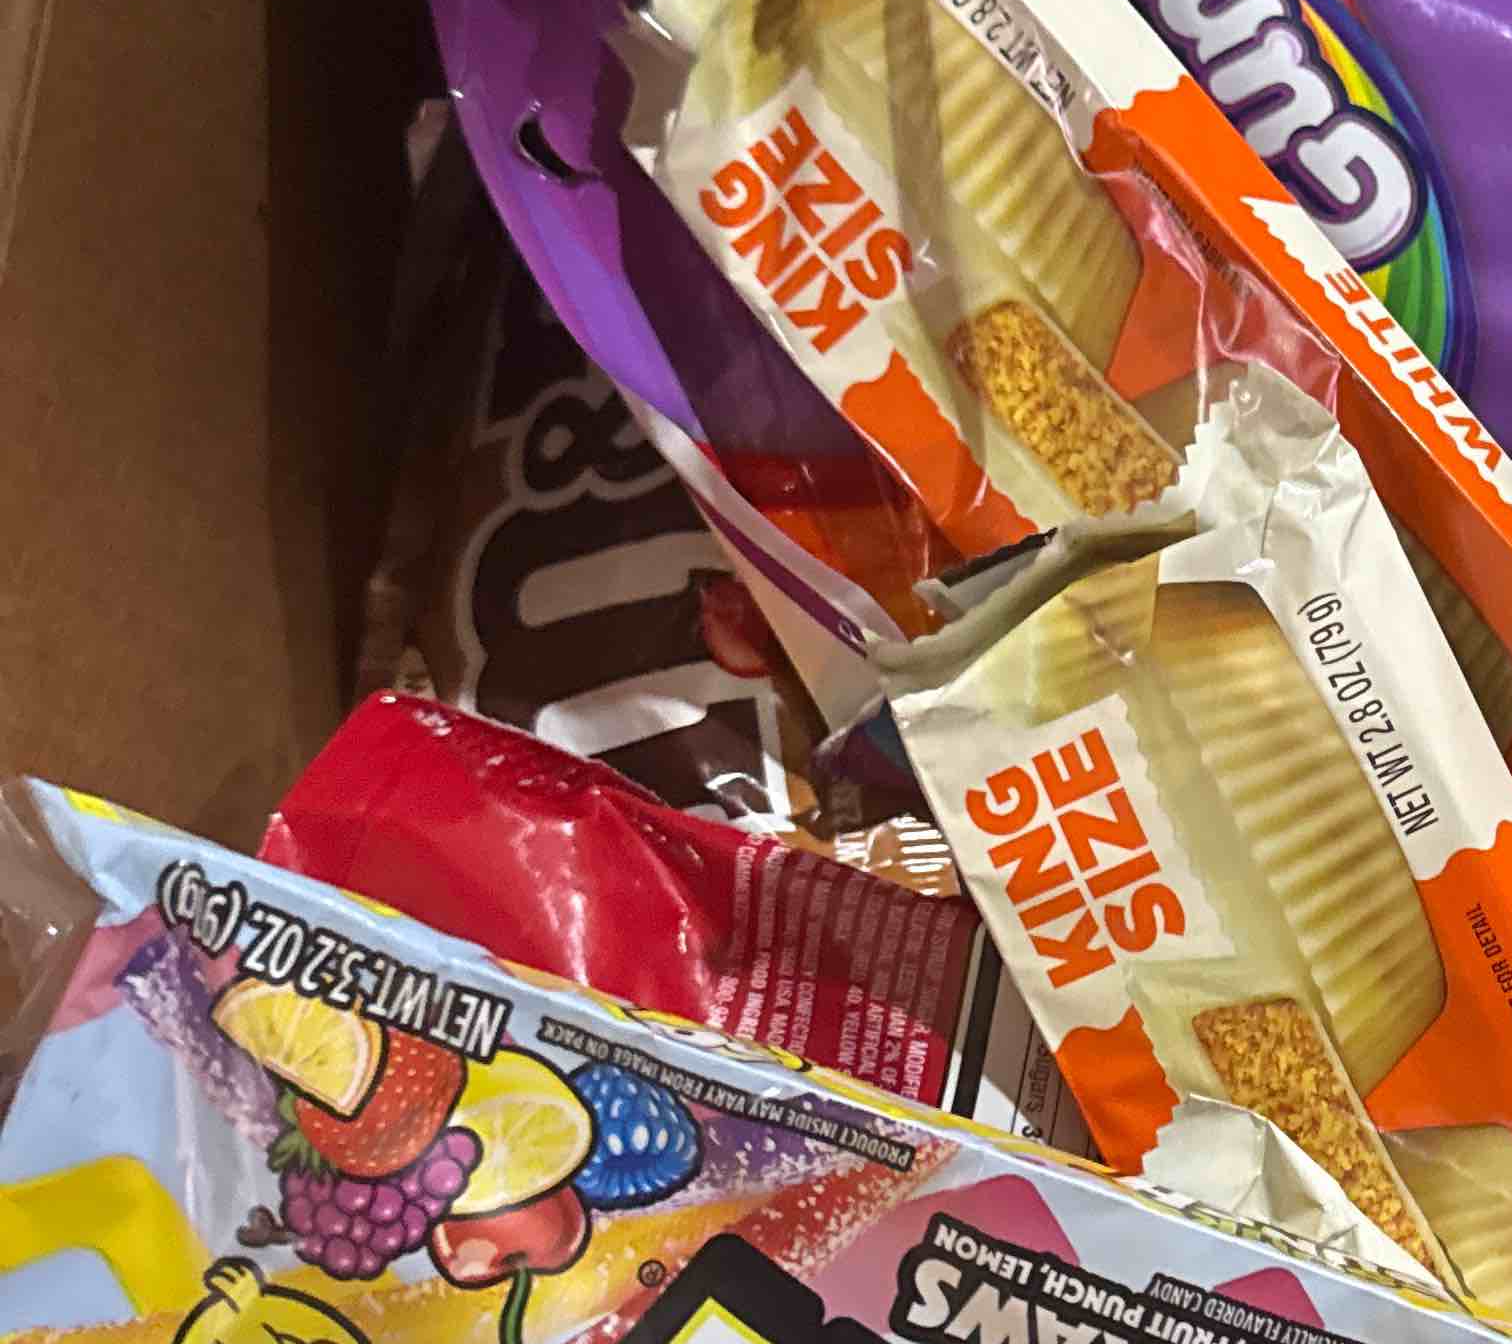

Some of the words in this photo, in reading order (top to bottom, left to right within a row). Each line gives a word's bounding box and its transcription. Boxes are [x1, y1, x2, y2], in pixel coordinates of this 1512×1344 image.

[1028, 62, 1078, 115] NET
[750, 104, 915, 301] SIZE
[701, 160, 868, 354] KING
[1321, 258, 1509, 475] WHITE
[1327, 659, 1375, 705] OZ
[1345, 695, 1397, 747] 2.8
[1365, 735, 1416, 787] WT
[1384, 776, 1441, 837] NET
[1031, 726, 1186, 957] SIZE
[965, 767, 1117, 990] KING
[235, 908, 308, 982] OZ.
[1462, 900, 1504, 960] DETAIL
[297, 933, 363, 1005] 3.2
[357, 957, 441, 1034] WT.
[426, 983, 507, 1058] NET
[540, 1017, 587, 1051] PACK
[581, 1034, 611, 1062] ON
[608, 1045, 661, 1082] IMAGE
[654, 1063, 706, 1100] FROM
[702, 1080, 750, 1114] VARY
[748, 1095, 786, 1125] MAY
[781, 1106, 839, 1143] INSIDE
[836, 1124, 913, 1168] PRODUCT
[927, 1221, 1037, 1286] LEMON
[1032, 1260, 1150, 1329] PUNCH,
[1145, 1274, 1205, 1313] CANDY
[1201, 1295, 1283, 1340] FLAVORED
